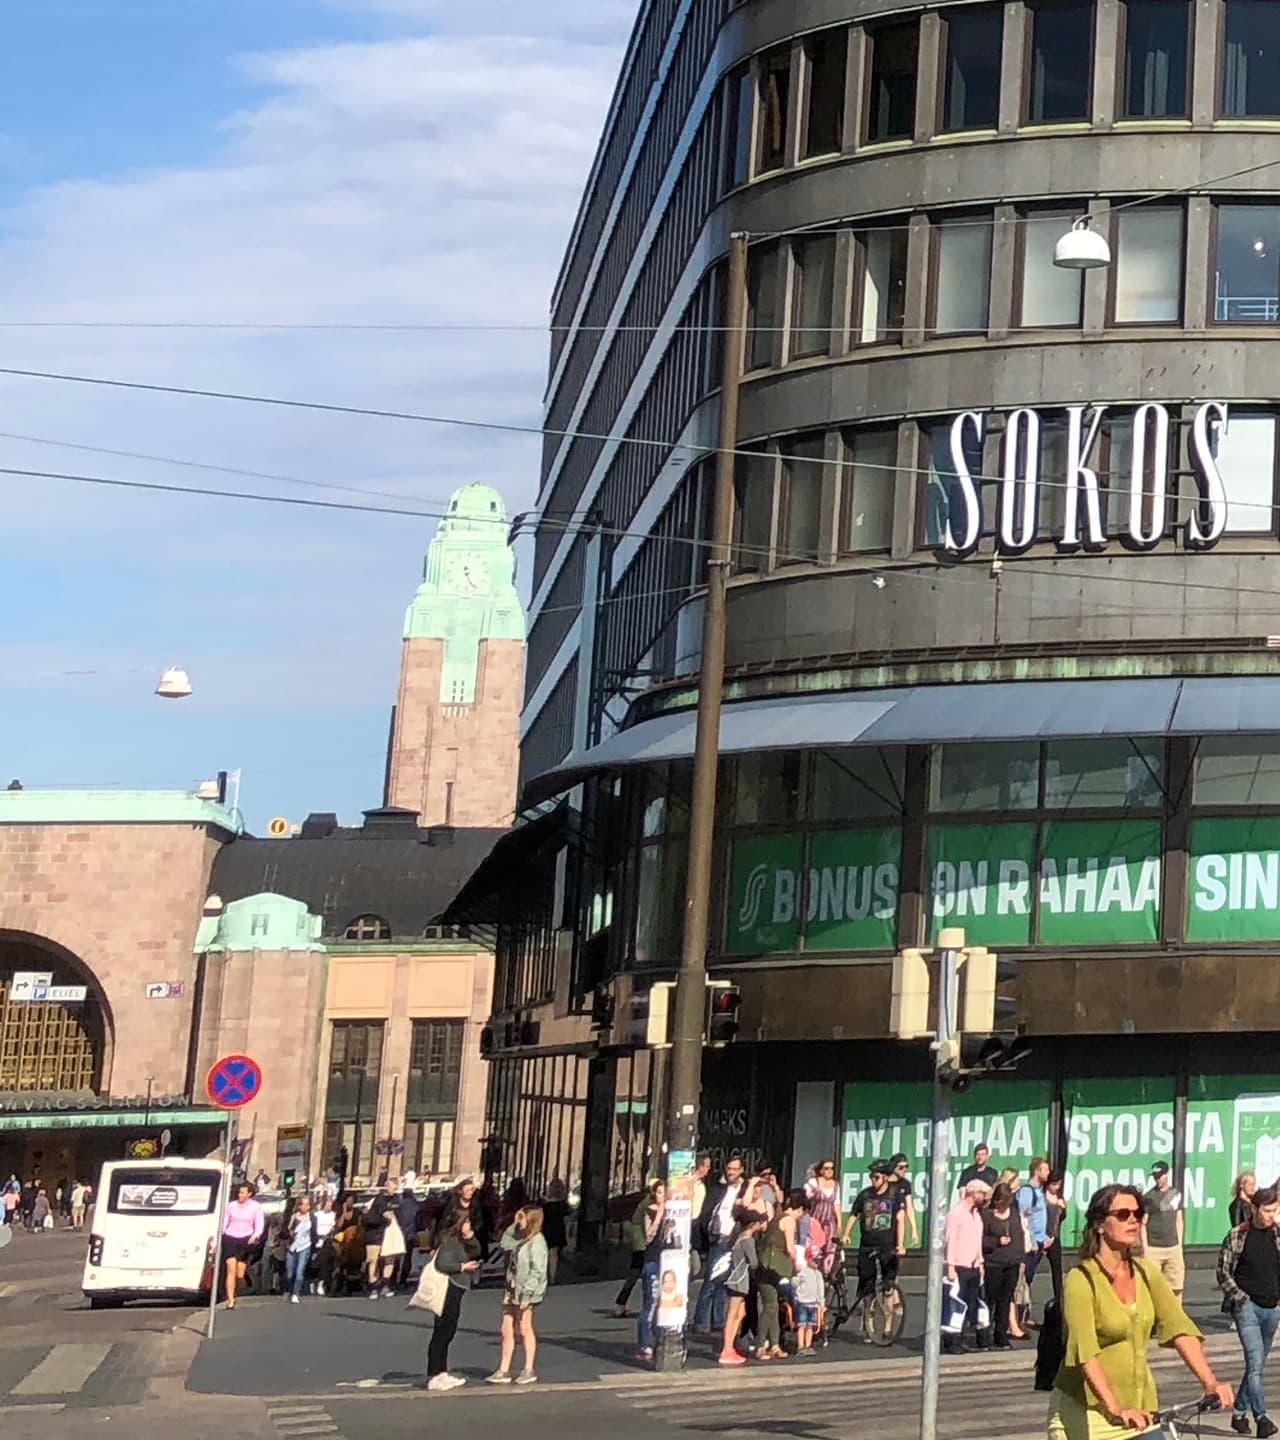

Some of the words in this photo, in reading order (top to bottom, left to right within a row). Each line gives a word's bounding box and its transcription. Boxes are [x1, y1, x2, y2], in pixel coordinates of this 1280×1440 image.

[945, 401, 1229, 550] SOKOS
[772, 862, 899, 923] BONUS
[932, 860, 988, 917] ON
[997, 856, 1161, 916] RAHAA
[844, 1118, 906, 1159] NYT
